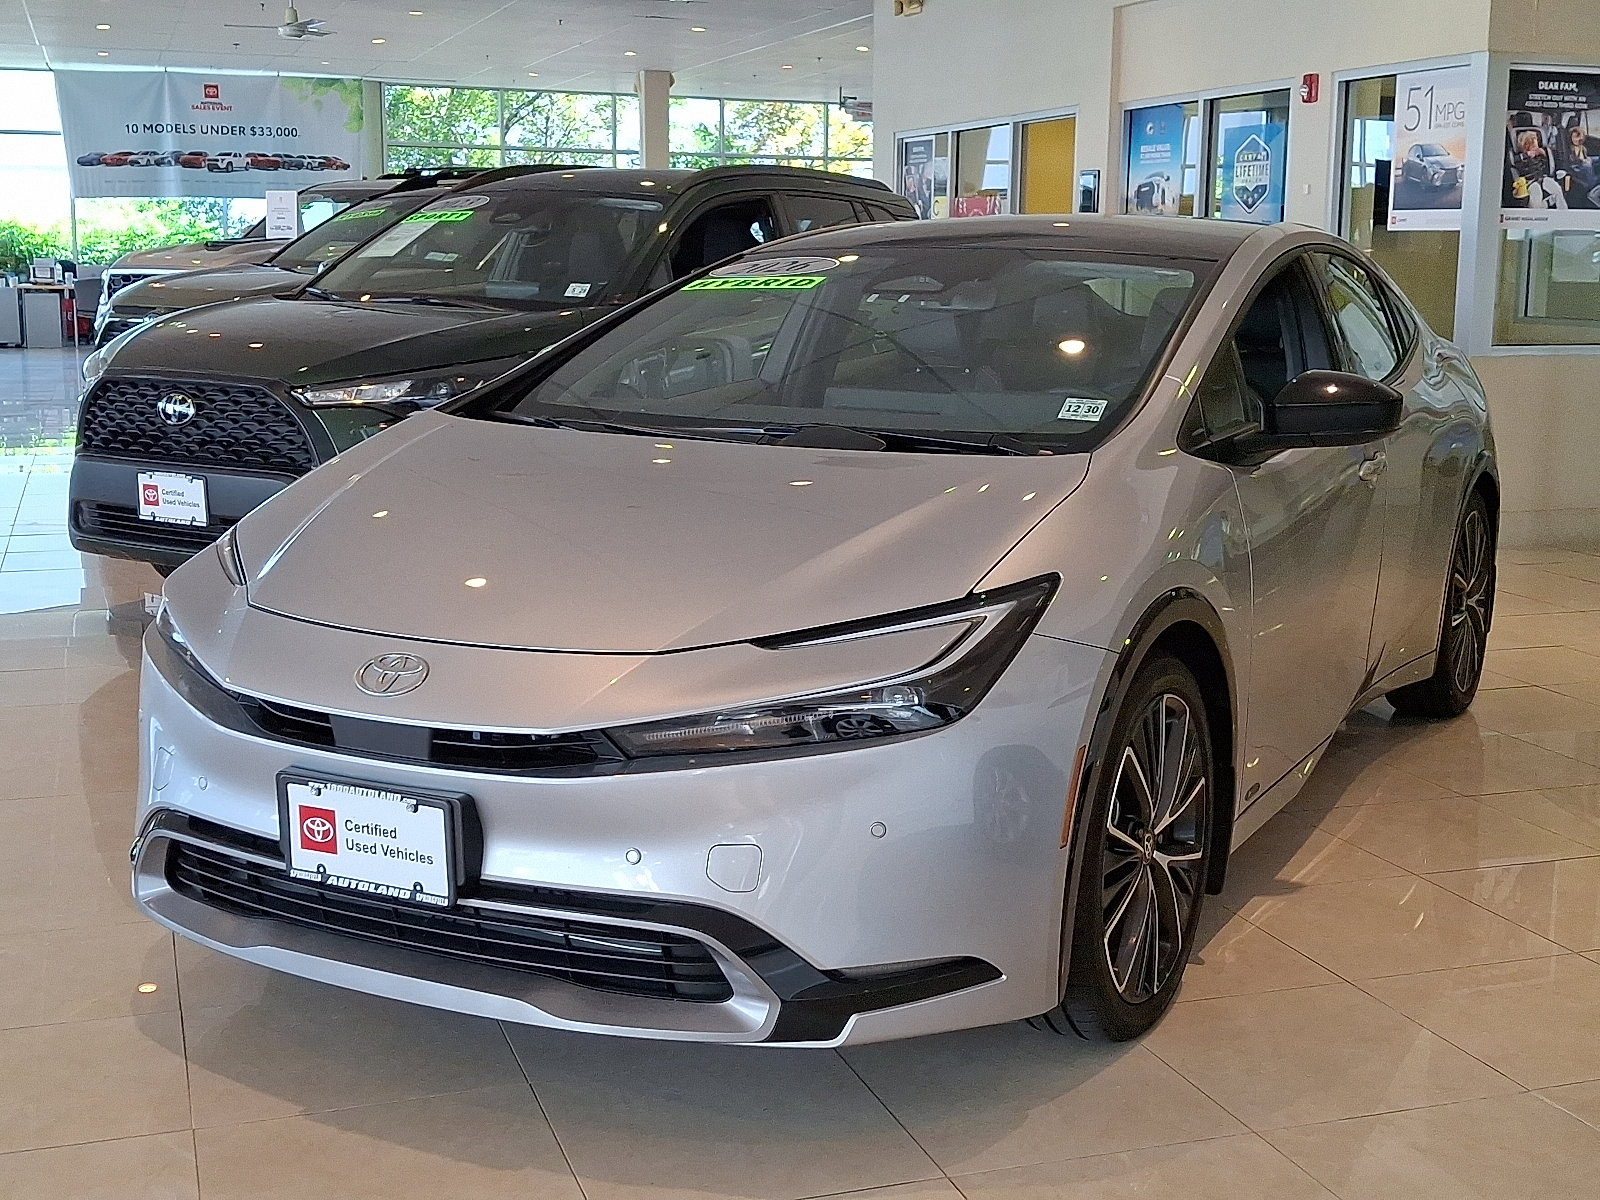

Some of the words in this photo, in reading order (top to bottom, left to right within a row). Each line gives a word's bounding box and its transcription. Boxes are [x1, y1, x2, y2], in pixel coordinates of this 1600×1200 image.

[1404, 85, 1434, 132] 51
[1435, 101, 1465, 122] MPG
[125, 123, 139, 134] 10
[142, 123, 197, 135] MODELS
[200, 124, 247, 136] UNDER
[1235, 163, 1269, 178] LIFETIME
[687, 278, 817, 289] HYBRID
[1065, 404, 1082, 413] 12
[1084, 405, 1100, 414] 30
[161, 488, 185, 497] Certified
[162, 498, 177, 506] Used
[177, 499, 200, 508] Vehicles
[344, 819, 397, 839] Certified
[345, 837, 377, 855] Used
[380, 843, 434, 865] Vehicles
[327, 875, 411, 899] AUTOLAND
